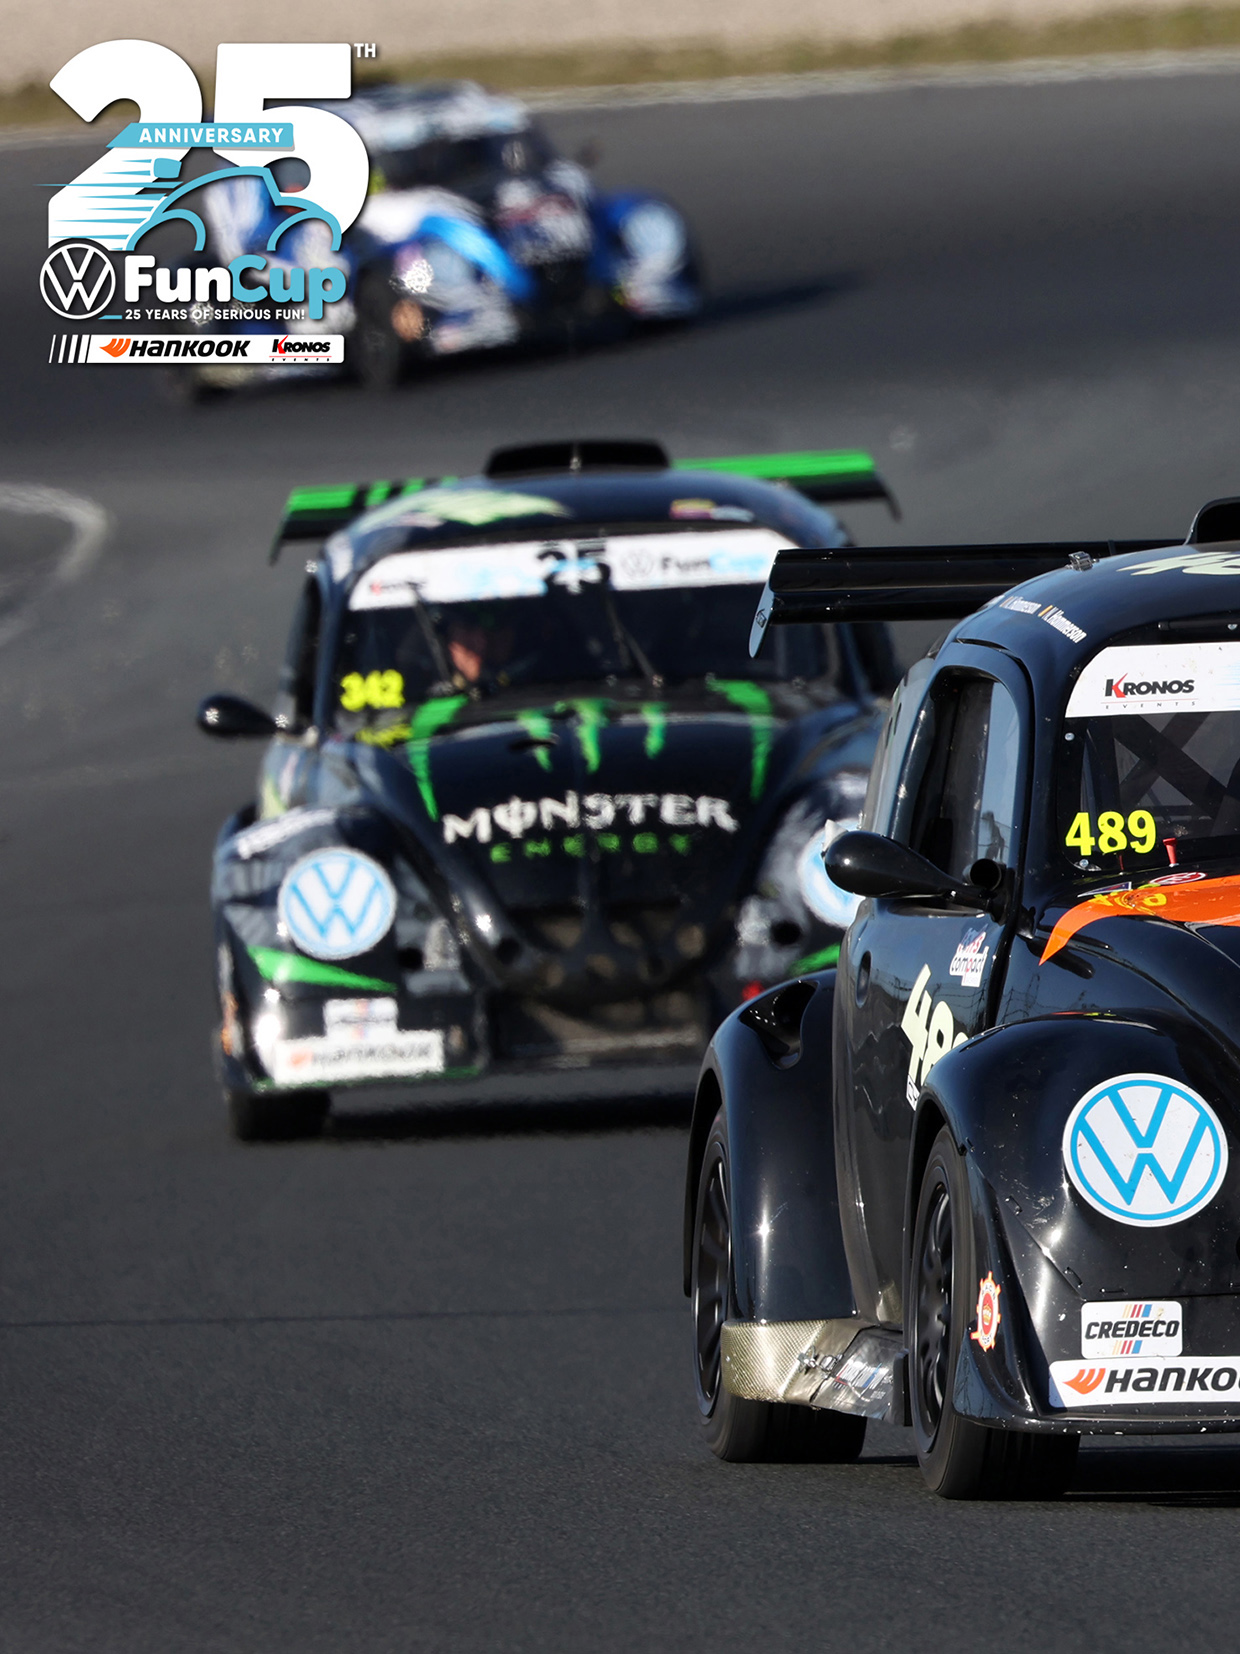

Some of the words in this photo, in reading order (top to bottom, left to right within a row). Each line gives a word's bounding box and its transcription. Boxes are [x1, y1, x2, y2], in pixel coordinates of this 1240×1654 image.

[340, 669, 405, 712] 342
[1104, 673, 1195, 698] KRONOS
[1105, 701, 1196, 709] EVENTS
[442, 789, 740, 844] MONSTER
[1065, 809, 1156, 856] 489
[1084, 1319, 1180, 1340] CREDECO
